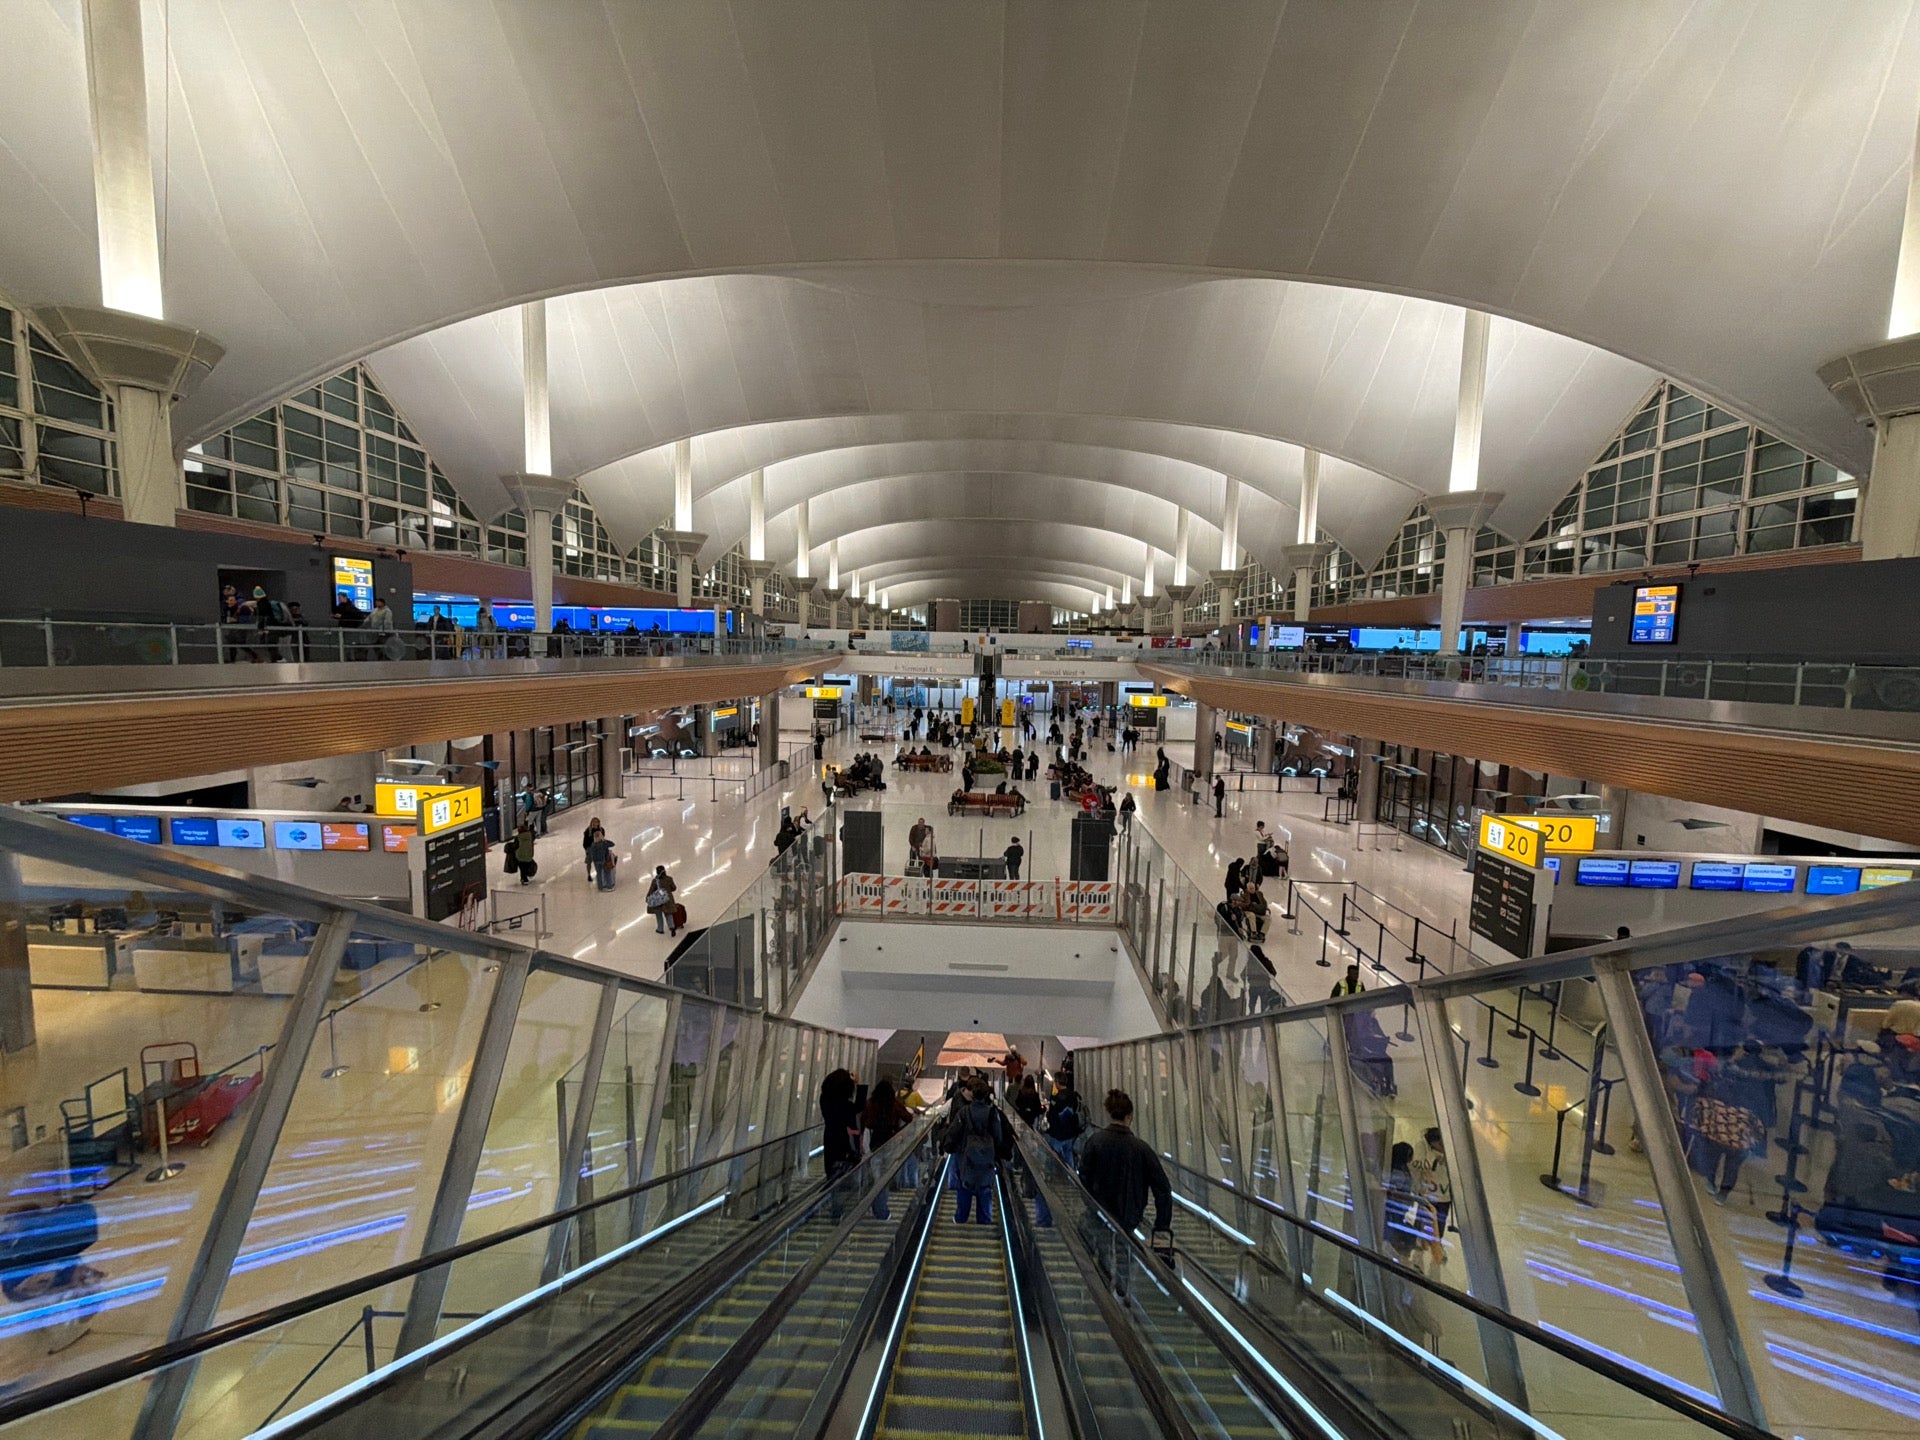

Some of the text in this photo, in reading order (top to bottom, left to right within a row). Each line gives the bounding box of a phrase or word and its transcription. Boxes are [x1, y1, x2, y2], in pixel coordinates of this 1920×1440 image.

[454, 797, 469, 818] 21
[1507, 832, 1528, 855] 20
[1545, 824, 1572, 843] 20
